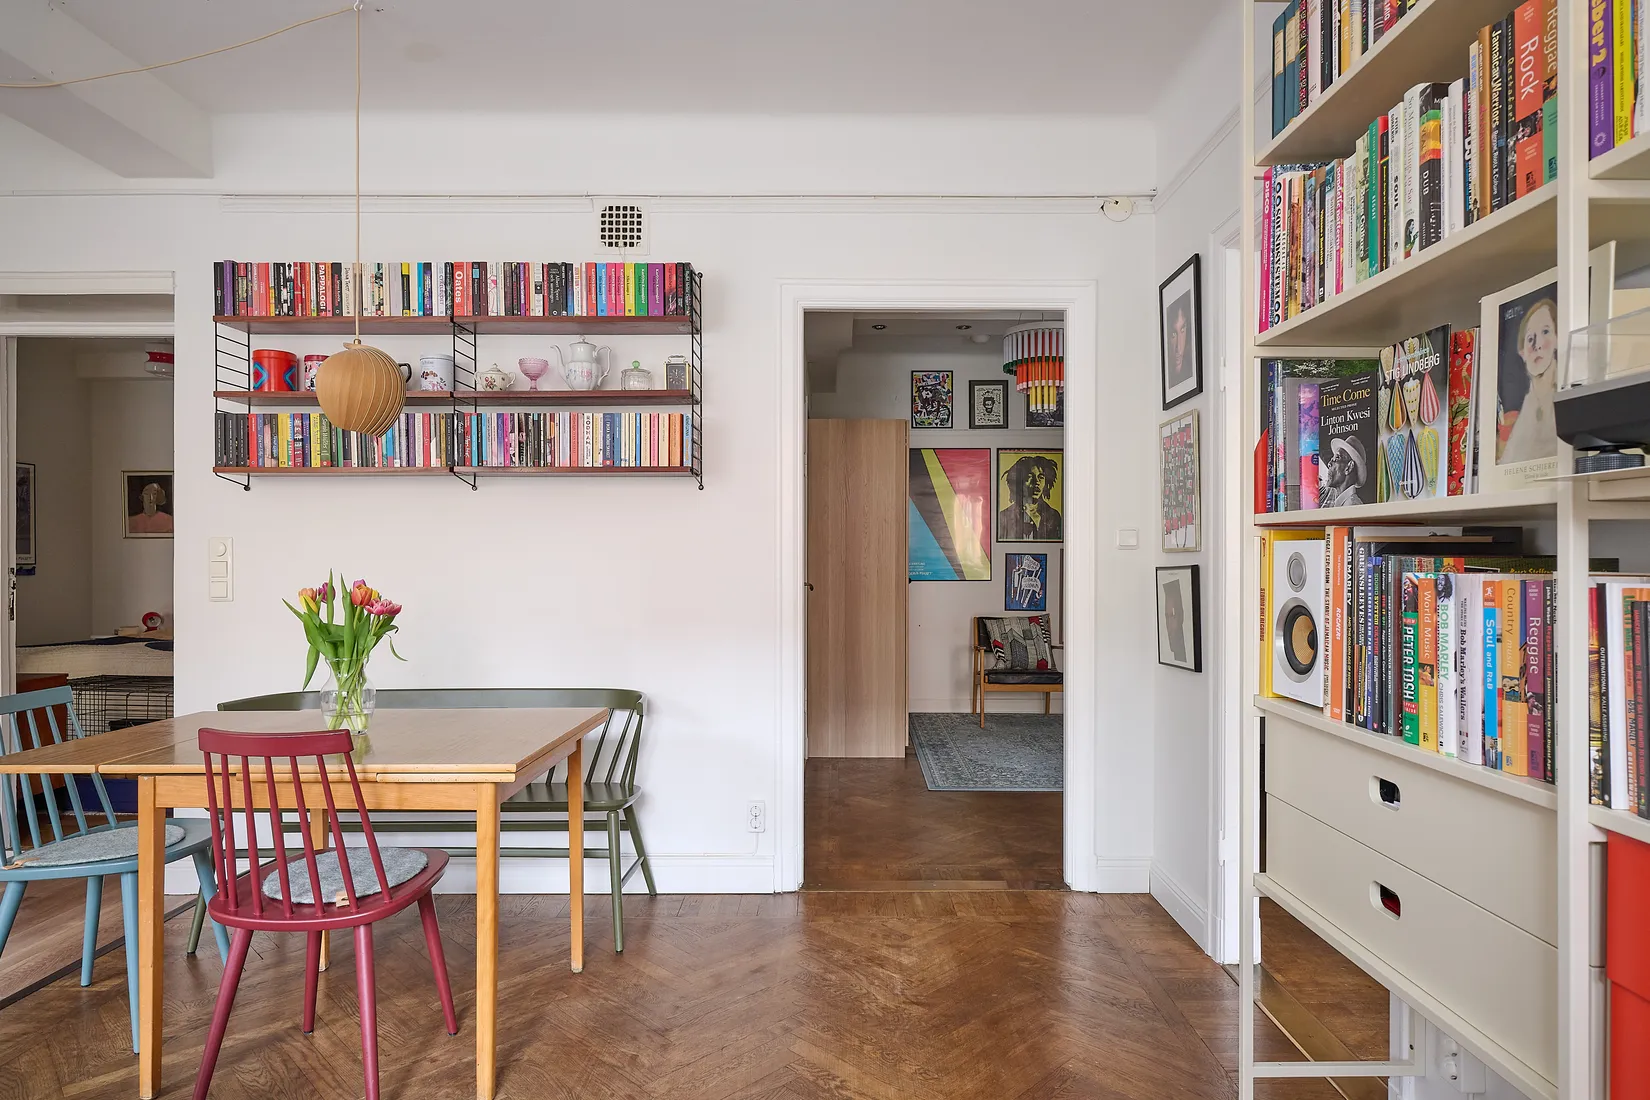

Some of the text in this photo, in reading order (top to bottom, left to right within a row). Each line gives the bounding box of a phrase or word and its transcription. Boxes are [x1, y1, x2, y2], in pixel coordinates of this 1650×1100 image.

[1543, 8, 1558, 74] Reggae
[1520, 35, 1539, 100] Rock
[1592, 48, 1607, 67] 2
[1490, 30, 1502, 128] Jamaican Warriors
[1507, 56, 1515, 123] Rastafari
[1406, 113, 1414, 138] Much
[1464, 136, 1472, 161] DJ
[1491, 152, 1499, 169] Roots
[1406, 177, 1414, 186] to
[1422, 170, 1430, 195] DUB
[1491, 175, 1499, 195] Culture
[455, 271, 464, 303] Oates
[1385, 367, 1400, 382] STIG
[1400, 353, 1440, 380] LINDBERG
[1320, 394, 1342, 407] Time
[1343, 388, 1370, 402] Come
[1321, 407, 1370, 426] Linton Kwesi
[1328, 423, 1358, 436] Johnson
[1423, 591, 1432, 659] World Music
[1485, 619, 1494, 648] Soul
[1506, 587, 1516, 669] Country music
[1403, 626, 1415, 664] PETER
[1440, 604, 1449, 681] BOB MARLEY
[1528, 617, 1541, 675] Reggae
[1403, 667, 1415, 701] TOSH
[1459, 629, 1467, 721] Bob Marley's Wailers
[1486, 672, 1494, 690] R&B
